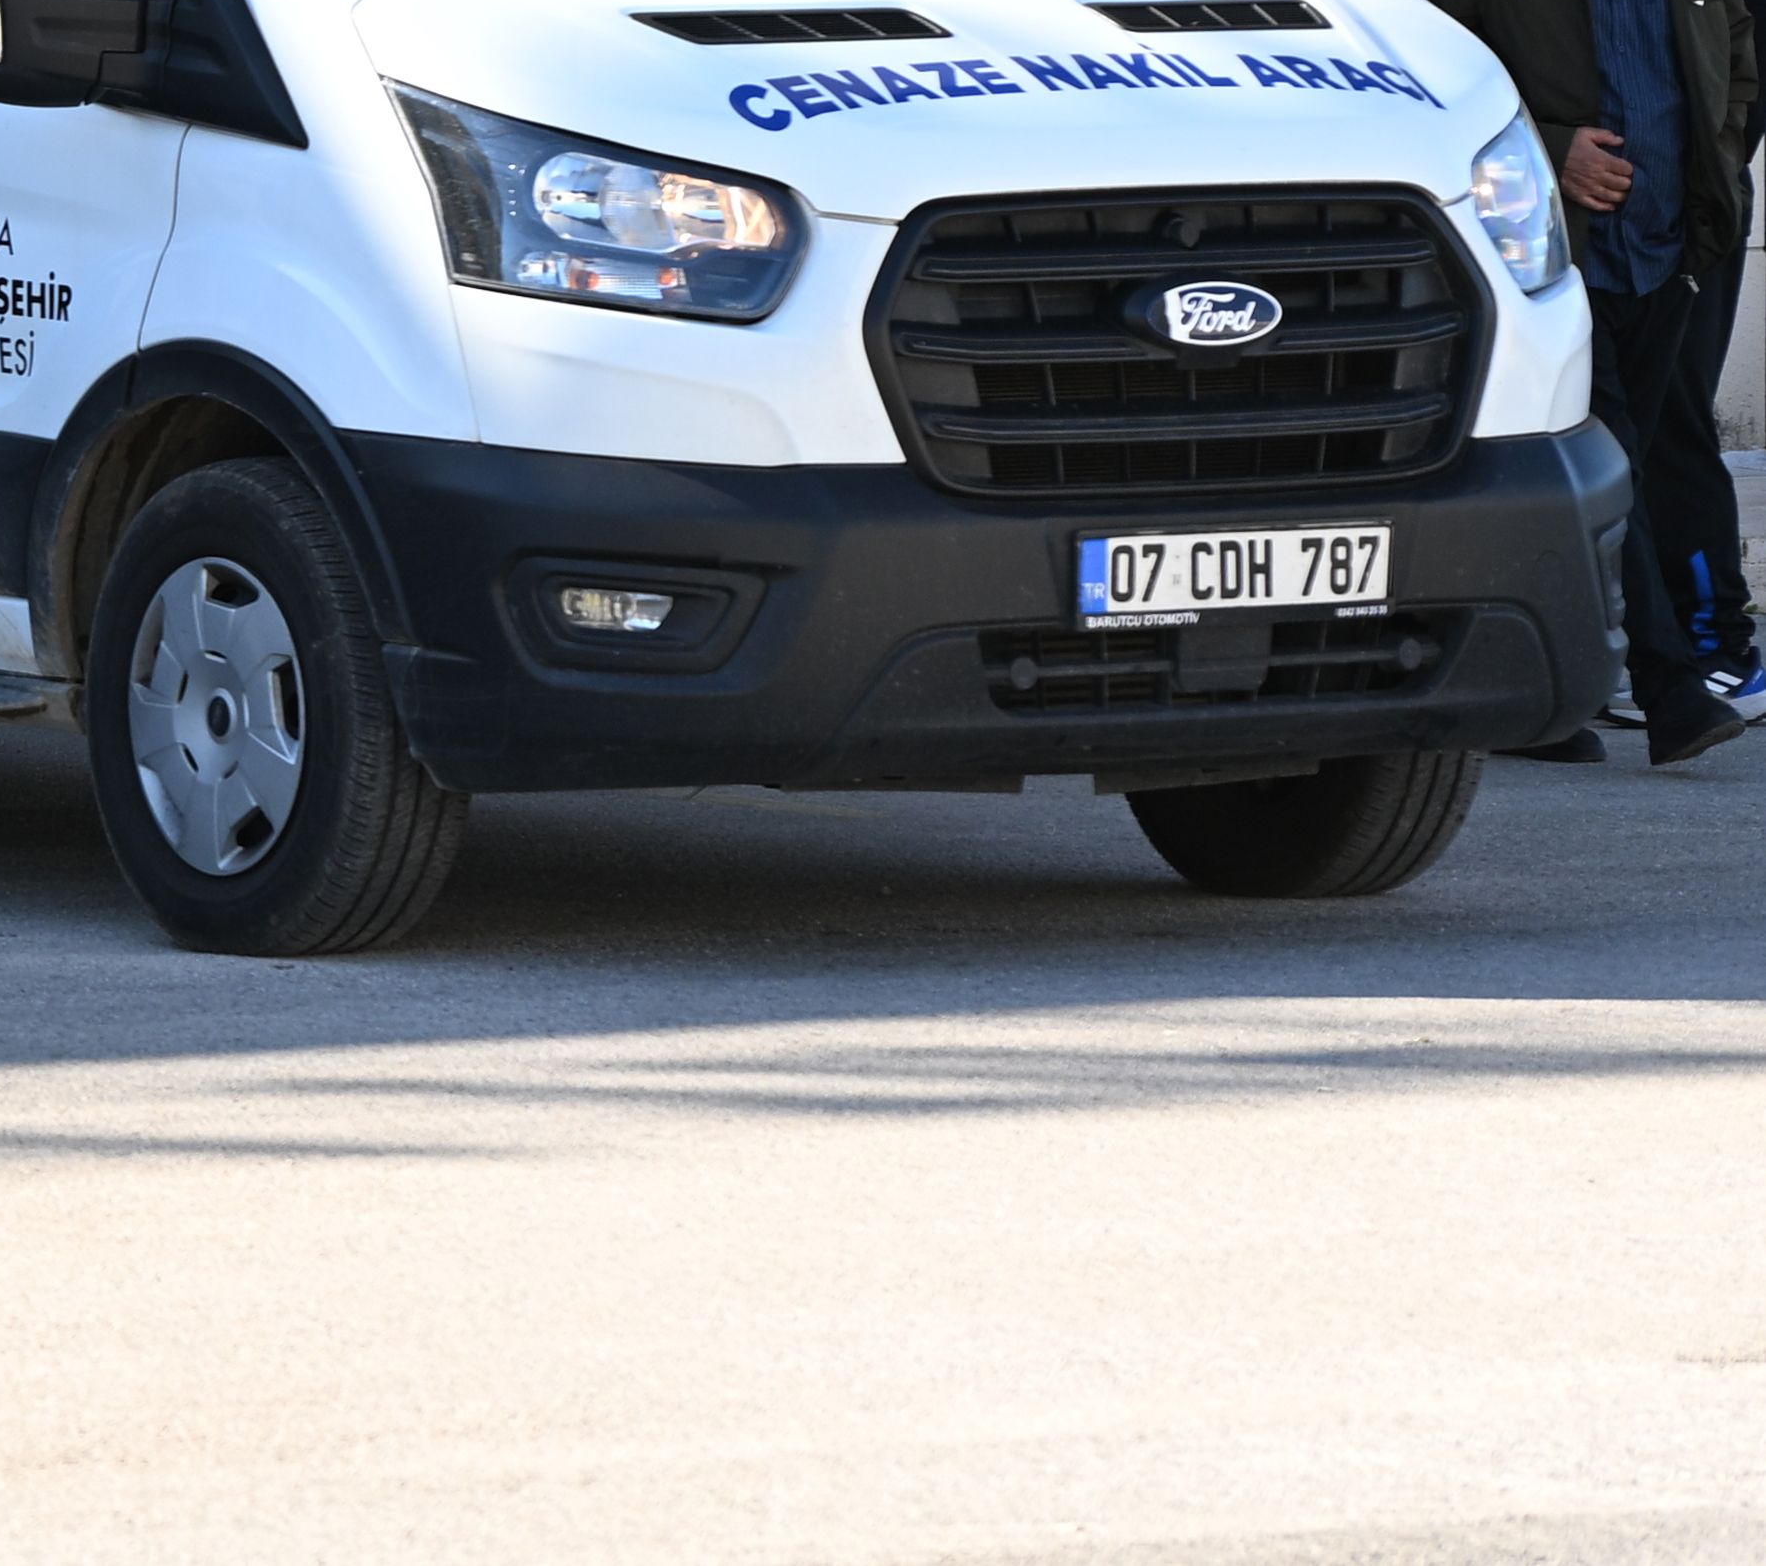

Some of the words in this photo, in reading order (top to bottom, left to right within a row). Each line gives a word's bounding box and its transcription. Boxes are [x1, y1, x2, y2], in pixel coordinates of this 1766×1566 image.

[728, 58, 1024, 132] CENAZE
[1012, 43, 1238, 89] NAKİL
[1236, 53, 1447, 110] ARACI
[1180, 291, 1256, 333] Ford
[1085, 583, 1105, 600] TR
[1110, 543, 1167, 602] 07
[1190, 538, 1274, 600] CDH
[1300, 535, 1381, 596] 787
